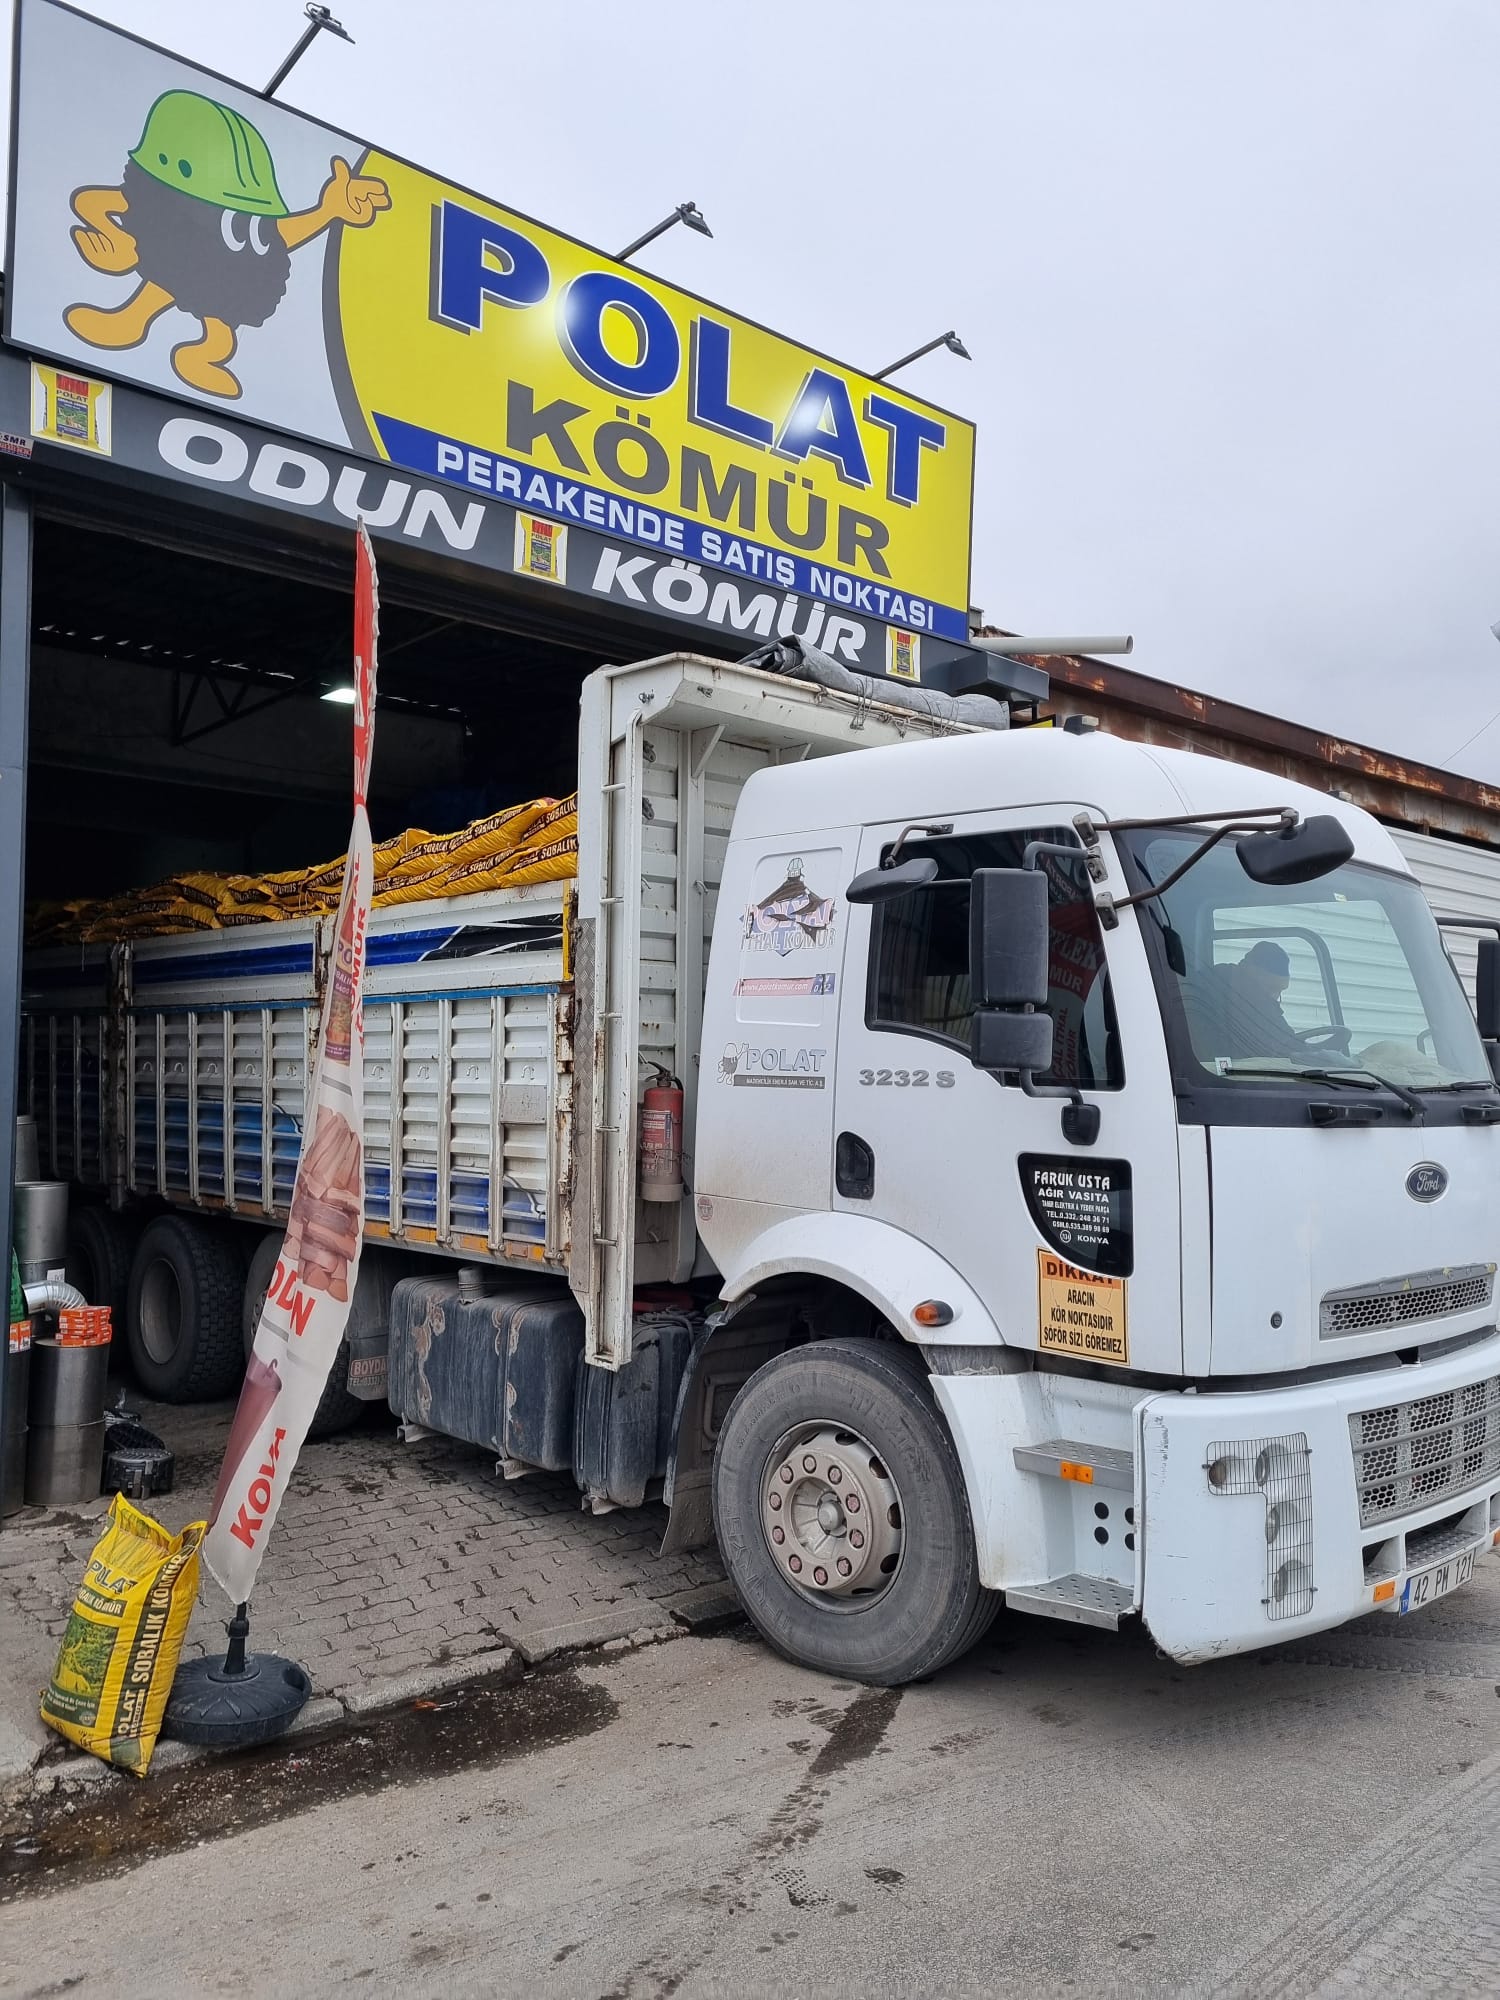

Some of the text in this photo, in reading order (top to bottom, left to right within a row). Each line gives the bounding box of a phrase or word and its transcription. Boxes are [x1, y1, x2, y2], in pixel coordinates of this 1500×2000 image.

[430, 198, 946, 508] POLAT
[56, 389, 87, 402] POLAT
[158, 417, 486, 551] ODUN
[506, 379, 894, 580] KÖMÜR
[437, 440, 935, 630] PERAKENDE SATIŞ NOKTASI
[592, 548, 867, 662] KÖMÜR
[546, 800, 577, 824] SOBALIK
[541, 838, 577, 861] SOBALIK
[746, 1048, 827, 1072] POLAT
[858, 1069, 956, 1088] 3232 S
[1034, 1171, 1110, 1190] FARUK USTA
[1417, 1170, 1440, 1192] Ford
[1038, 1187, 1109, 1203] AĞIR VASITA
[1078, 1235, 1109, 1245] KONYA
[1068, 1289, 1095, 1307] ARACIN
[1051, 1305, 1113, 1331] KÖR NOKTASIDIR
[1044, 1325, 1122, 1353] ŞÖFÖR SİZİ GÖREMEZ
[353, 1358, 386, 1376] BOYDA
[1414, 1576, 1429, 1605] 42
[117, 1690, 137, 1737] OLAT
[131, 1612, 166, 1683] SOBALIK
[151, 1554, 186, 1611] KÖMÜR
